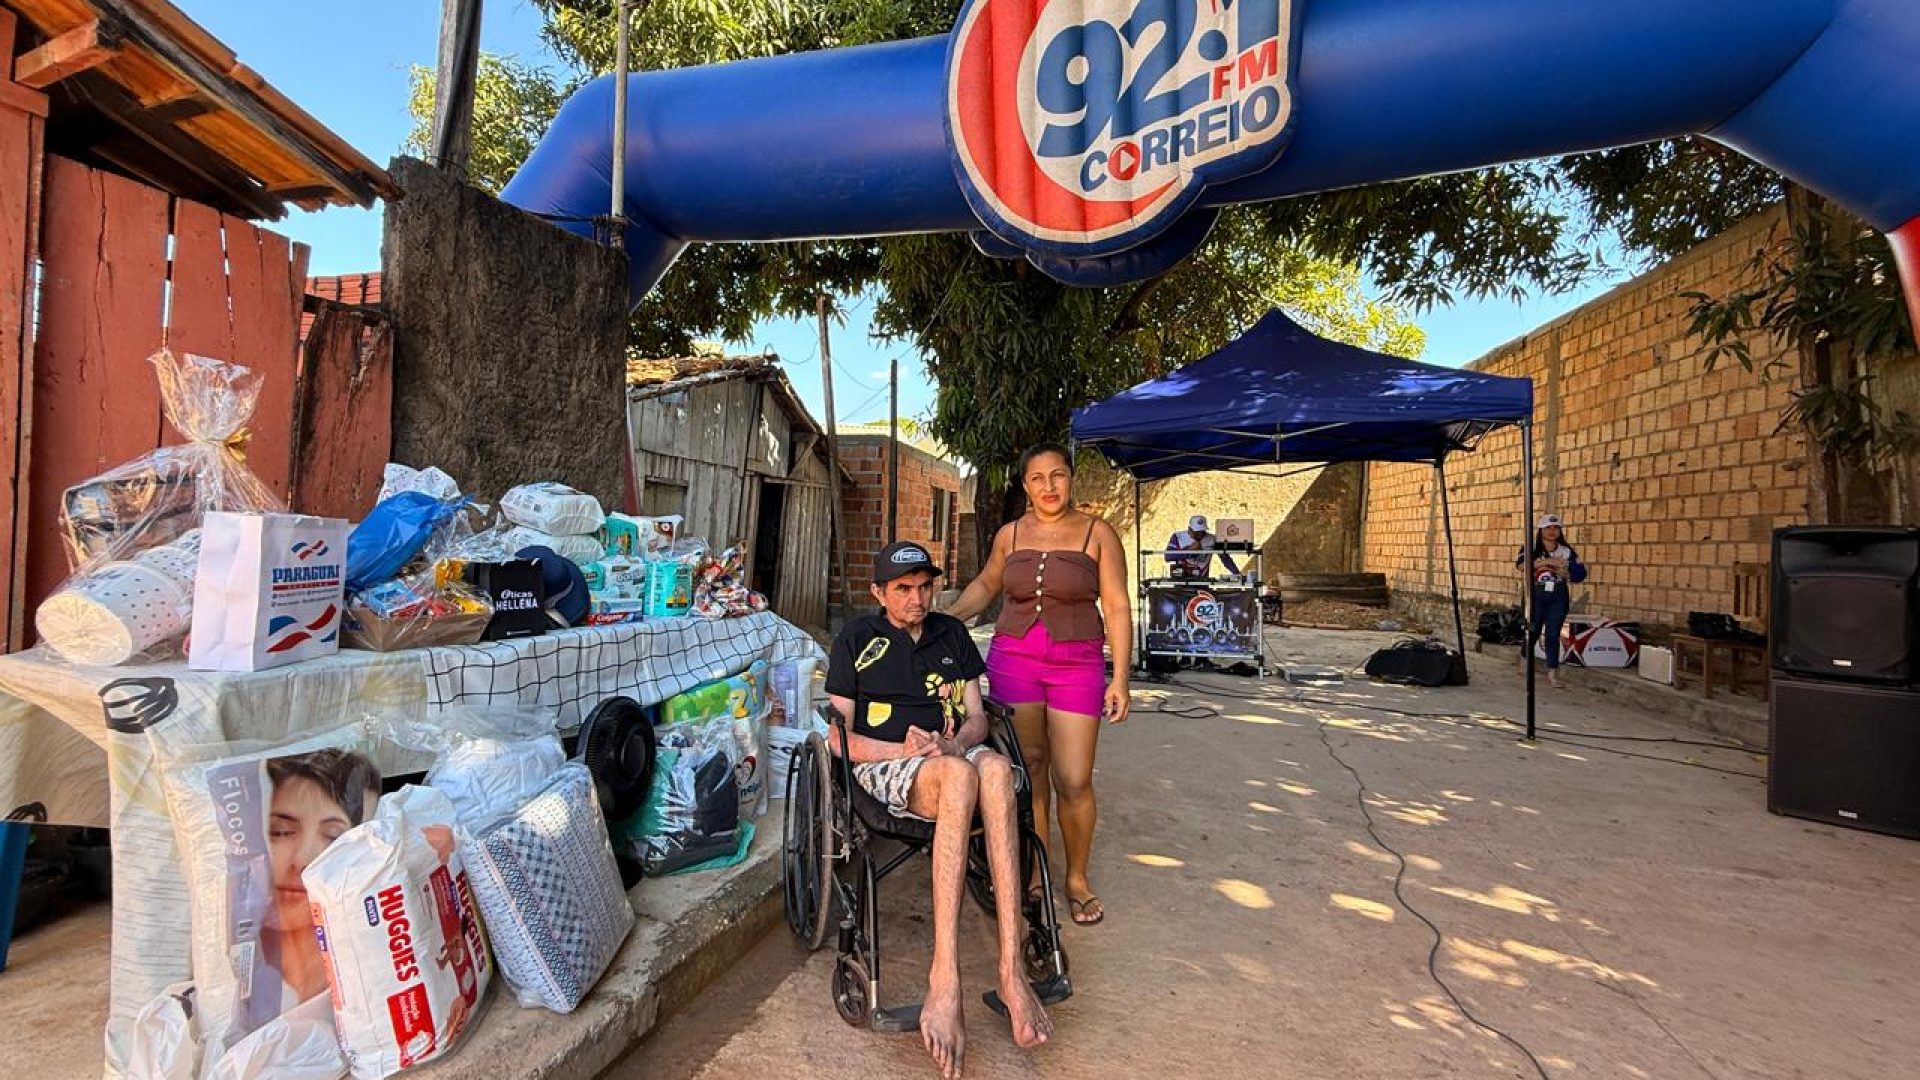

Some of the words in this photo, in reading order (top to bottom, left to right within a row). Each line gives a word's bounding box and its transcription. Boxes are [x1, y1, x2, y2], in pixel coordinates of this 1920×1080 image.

[1212, 40, 1278, 101] FM
[1079, 85, 1281, 192] CORREIO
[272, 564, 340, 583] PARAGUAI
[495, 597, 539, 611] HELLENA
[217, 775, 249, 857] Flocos
[377, 884, 420, 983] HUGGIES
